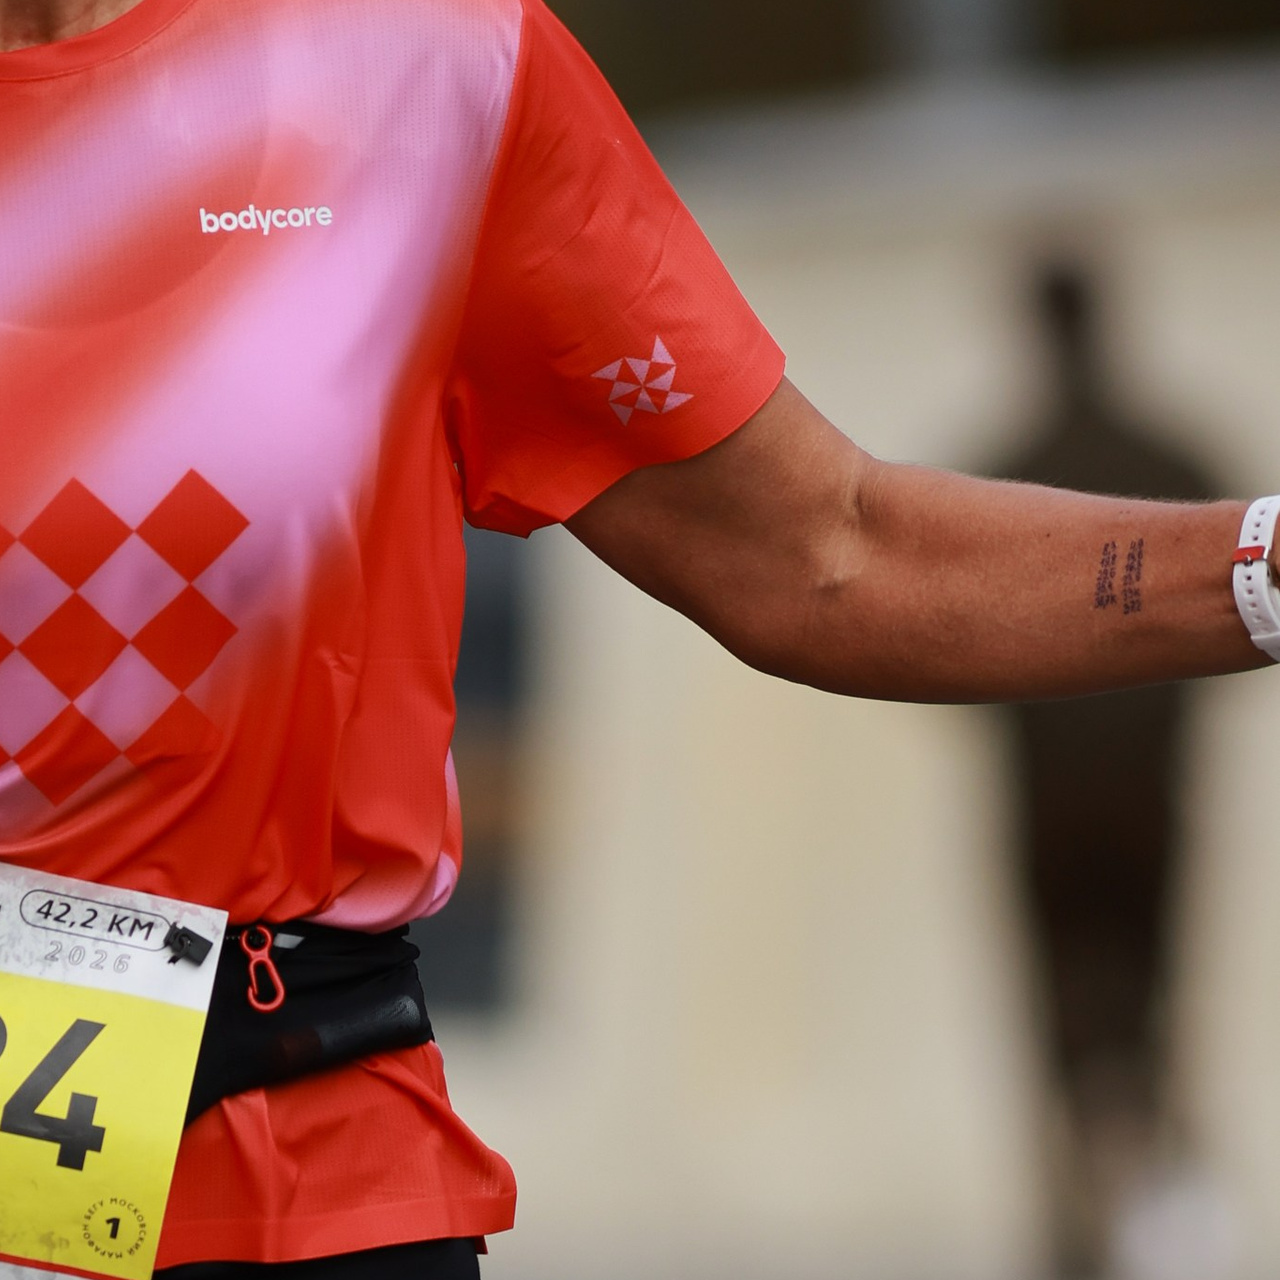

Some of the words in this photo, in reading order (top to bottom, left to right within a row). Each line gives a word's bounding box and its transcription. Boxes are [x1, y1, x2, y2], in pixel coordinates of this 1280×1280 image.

[199, 204, 332, 235] bodycore
[36, 899, 98, 929] 42,2
[108, 914, 154, 941] КМ
[44, 940, 131, 973] 2026
[83, 1224, 123, 1259] МАРАФОН
[106, 1217, 120, 1240] 1
